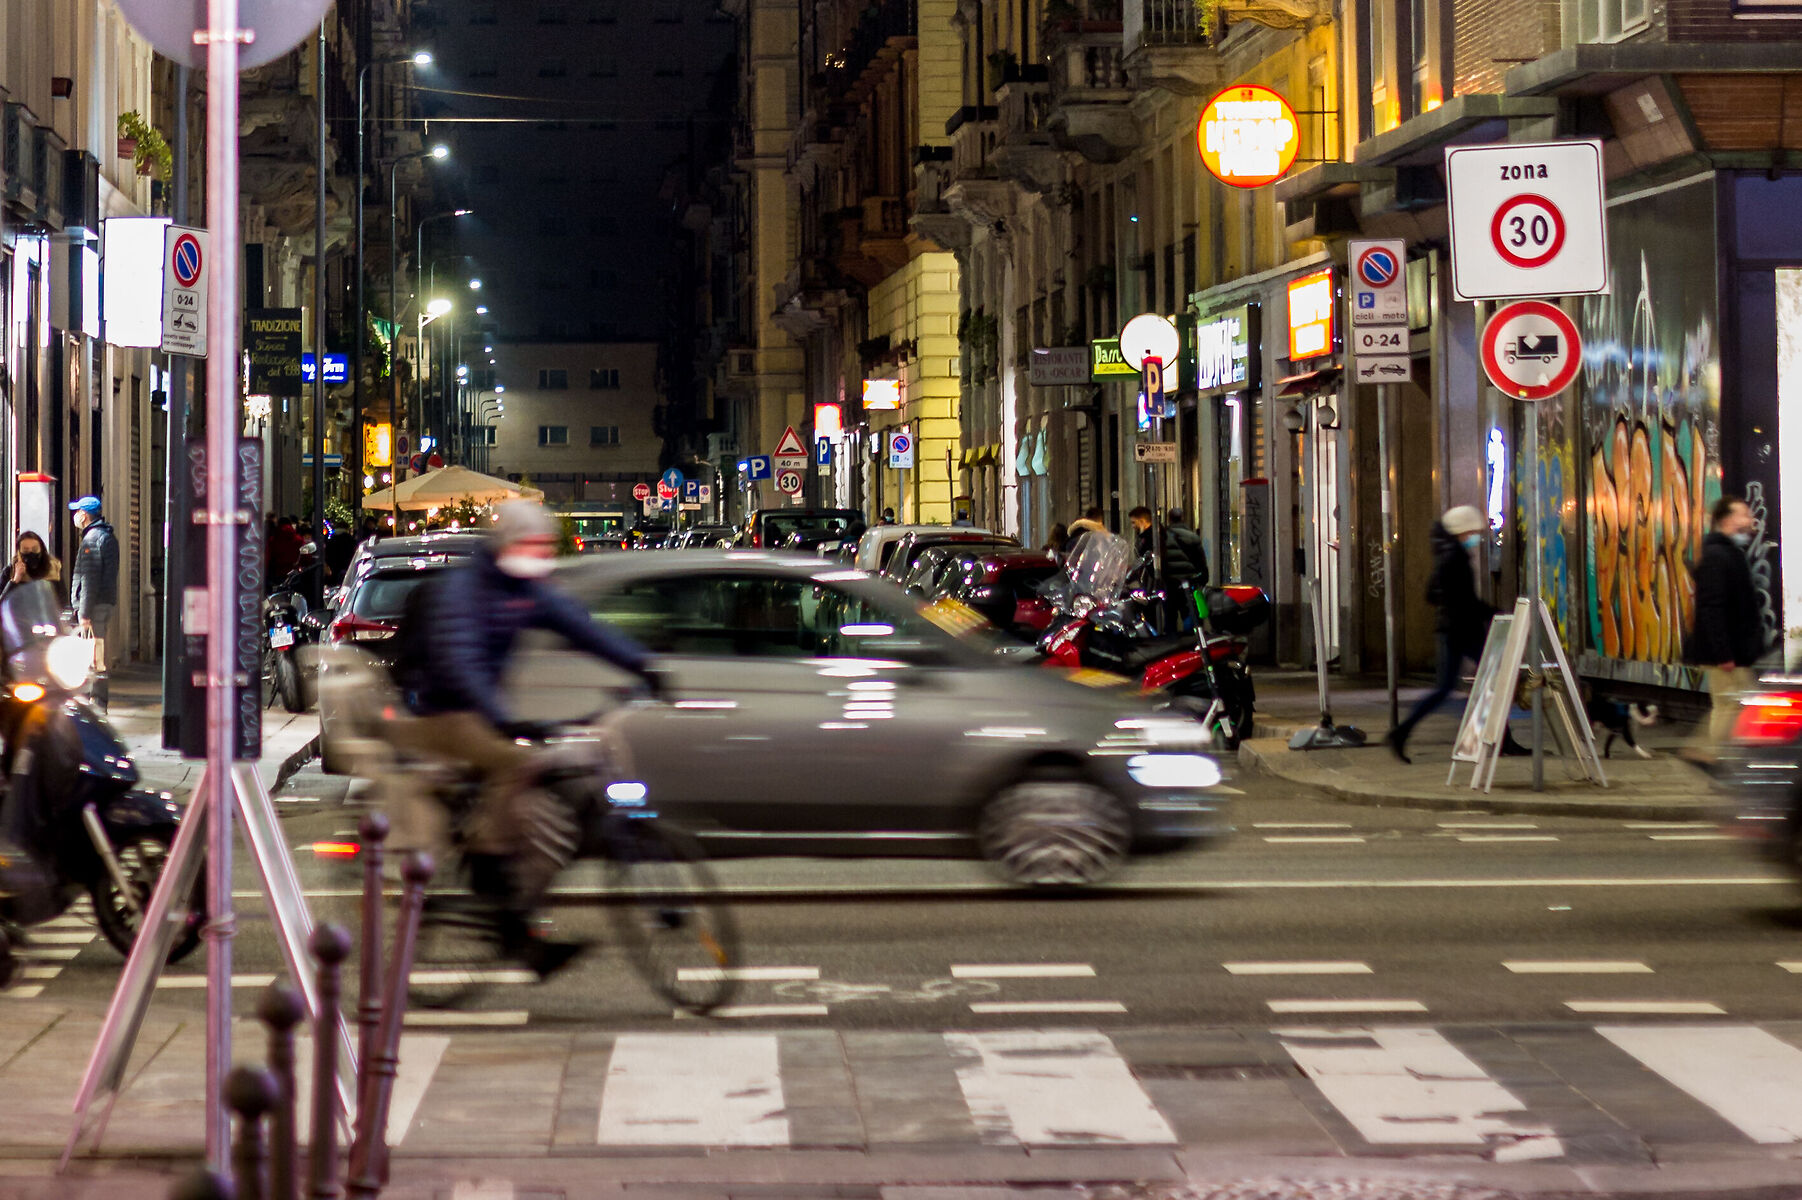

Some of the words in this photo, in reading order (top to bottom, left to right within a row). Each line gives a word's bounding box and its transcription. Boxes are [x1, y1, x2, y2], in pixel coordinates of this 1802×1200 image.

[1500, 164, 1549, 180] zona
[1510, 215, 1549, 247] 30
[177, 294, 194, 306] 0-24
[1361, 294, 1371, 307] P
[1355, 312, 1375, 320] cicli
[1382, 311, 1406, 319] moto
[250, 320, 302, 332] TRADIZIONE
[1362, 333, 1401, 347] 0-24
[1147, 363, 1160, 408] P
[819, 439, 828, 462] P
[751, 458, 766, 478] P
[686, 481, 697, 495] P
[782, 476, 798, 489] 30
[634, 488, 649, 496] STOP
